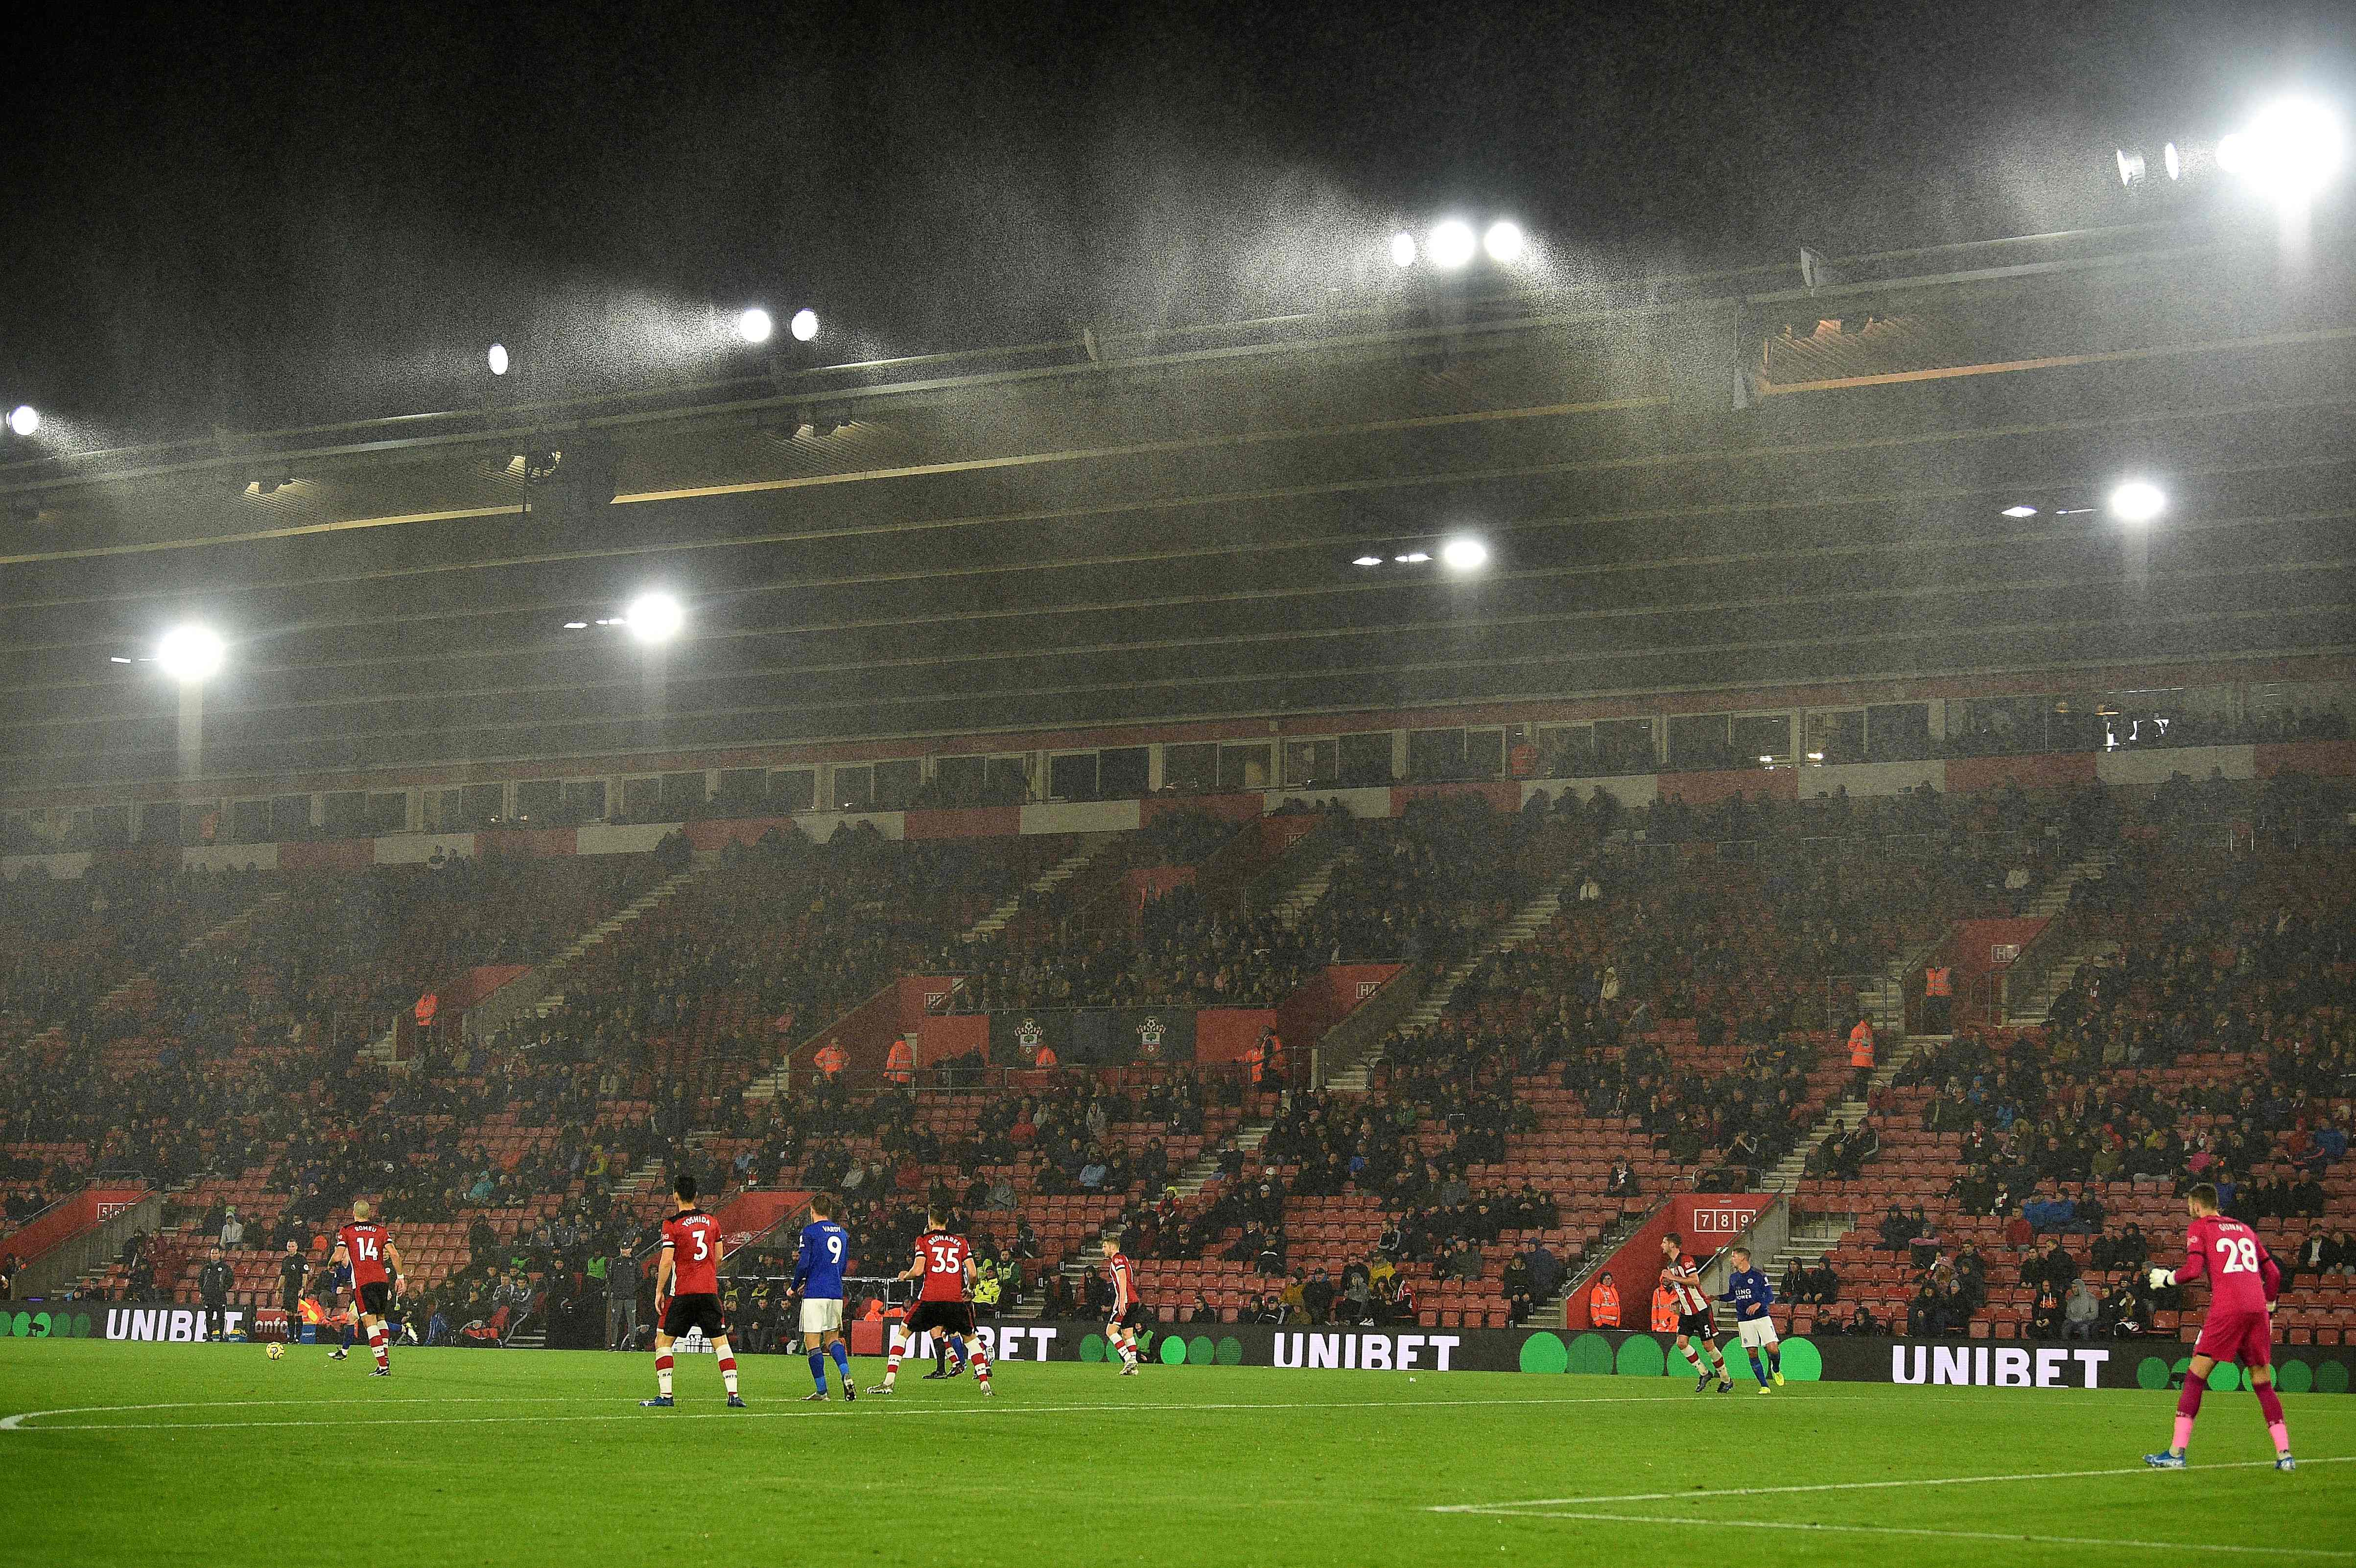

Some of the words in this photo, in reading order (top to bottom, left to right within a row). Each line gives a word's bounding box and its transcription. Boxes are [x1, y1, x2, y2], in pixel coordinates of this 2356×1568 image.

[682, 1216, 710, 1227] YOSHIDA
[1701, 1215, 1709, 1227] 7
[1721, 1215, 1729, 1227] 8
[2218, 1223, 2243, 1232] GUNN
[356, 1237, 378, 1261] 14
[692, 1230, 708, 1261] 3
[827, 1236, 842, 1264] 9
[928, 1236, 962, 1247] BEDNAREK
[931, 1246, 960, 1274] 35
[2215, 1238, 2258, 1274] 28
[889, 1325, 1057, 1361] UNBET
[1704, 1324, 1710, 1334] 5
[1273, 1332, 1460, 1371] UNIBET
[1892, 1345, 2109, 1388] UNIBET
